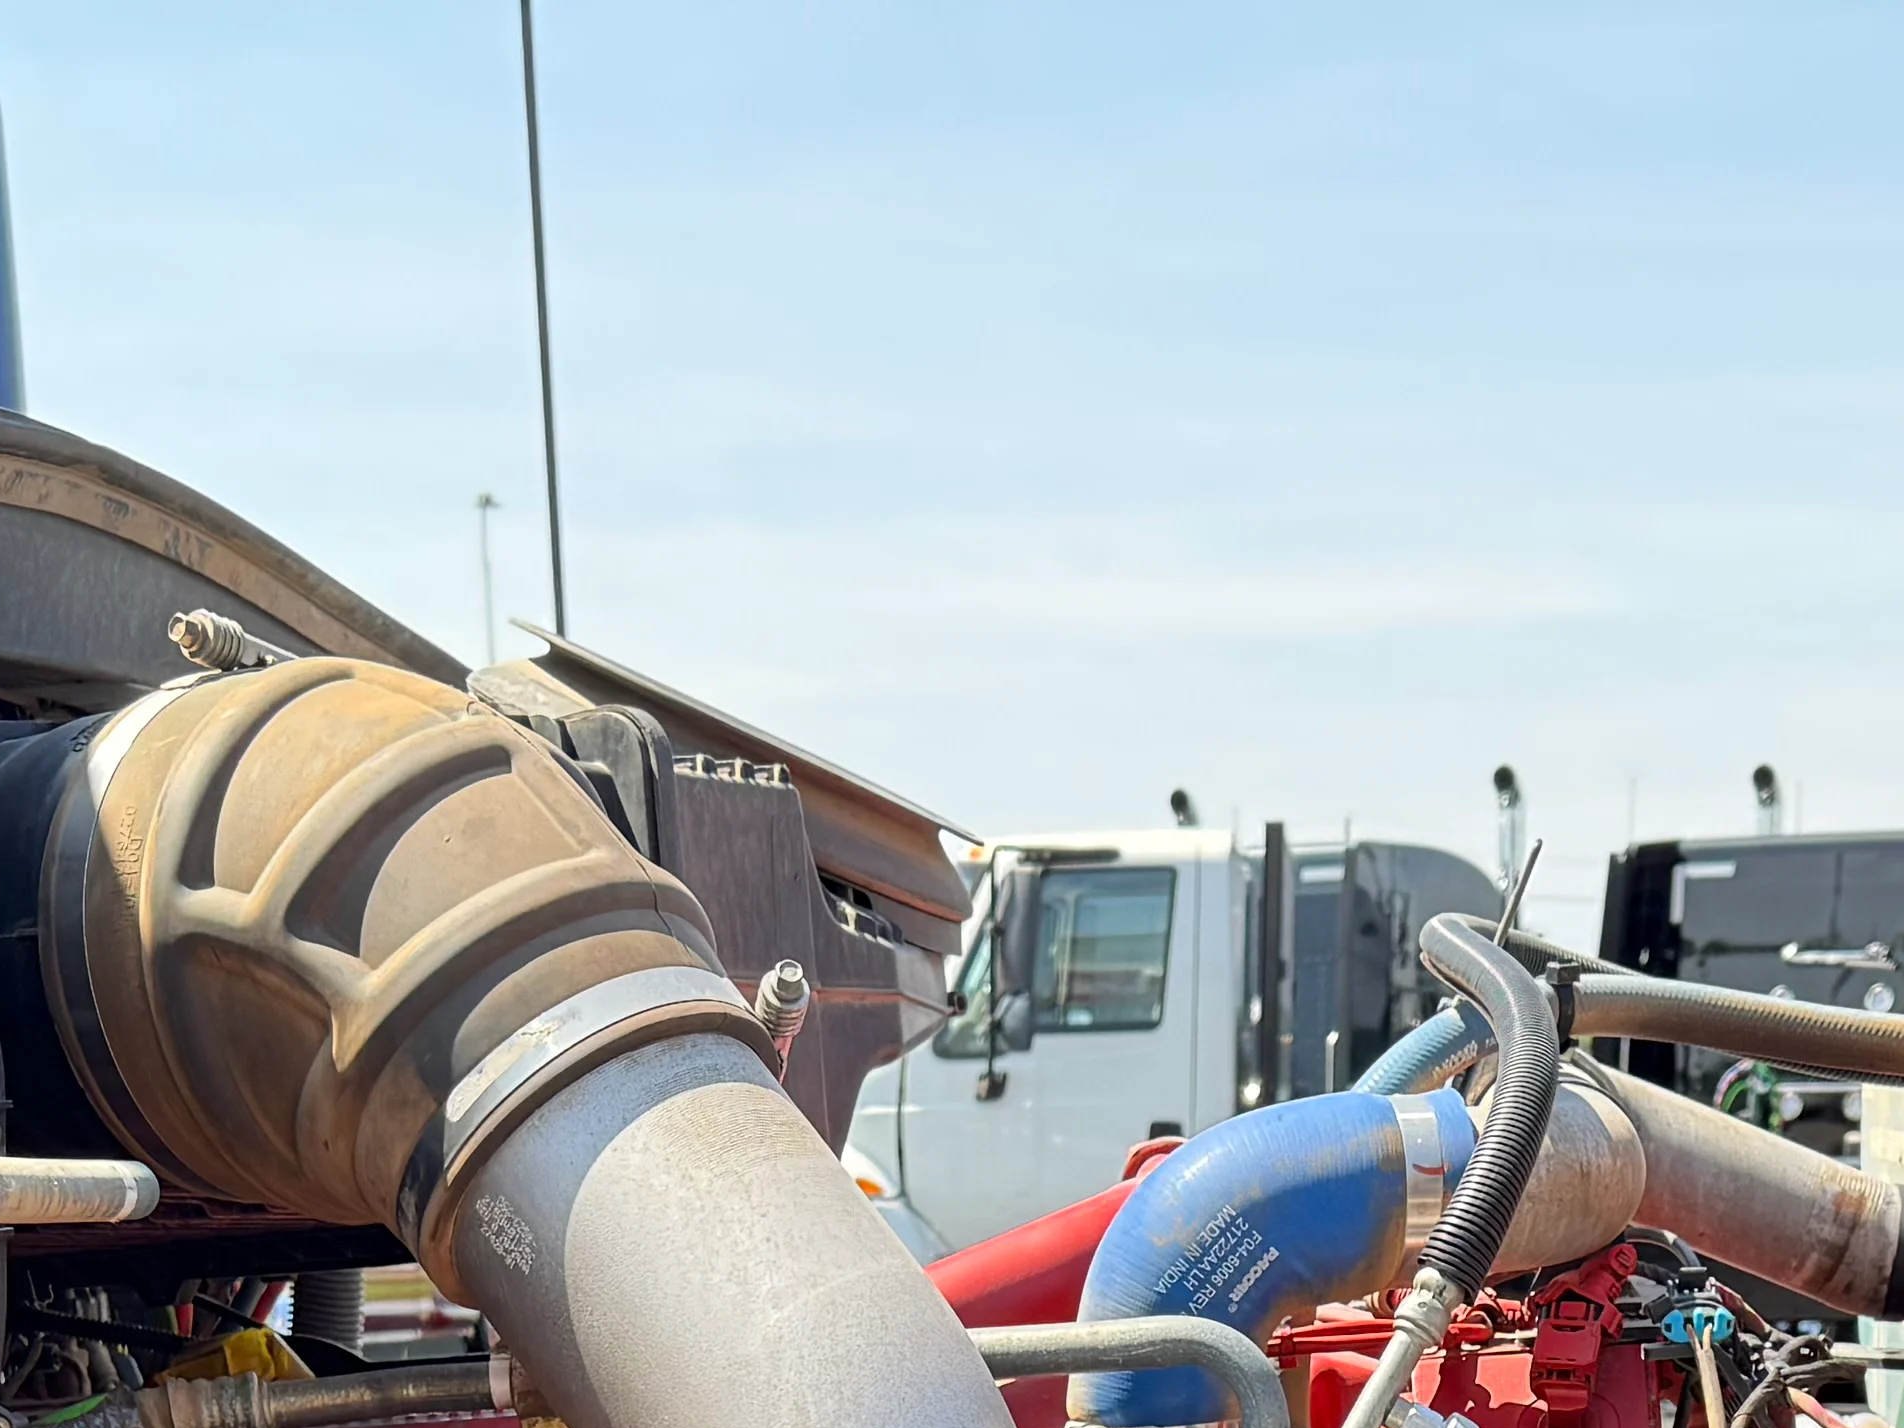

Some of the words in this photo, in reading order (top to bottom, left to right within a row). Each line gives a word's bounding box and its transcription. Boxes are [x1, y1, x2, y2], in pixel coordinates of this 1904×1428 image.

[1196, 1205, 1236, 1247] MADE
[1185, 1243, 1202, 1261] IN
[1211, 1230, 1263, 1286] F04-6006
[1153, 1258, 1189, 1294] INDIA
[1183, 1269, 1204, 1291] LH
[1229, 1247, 1279, 1301] PACCAR
[1188, 1284, 1216, 1315] REV
